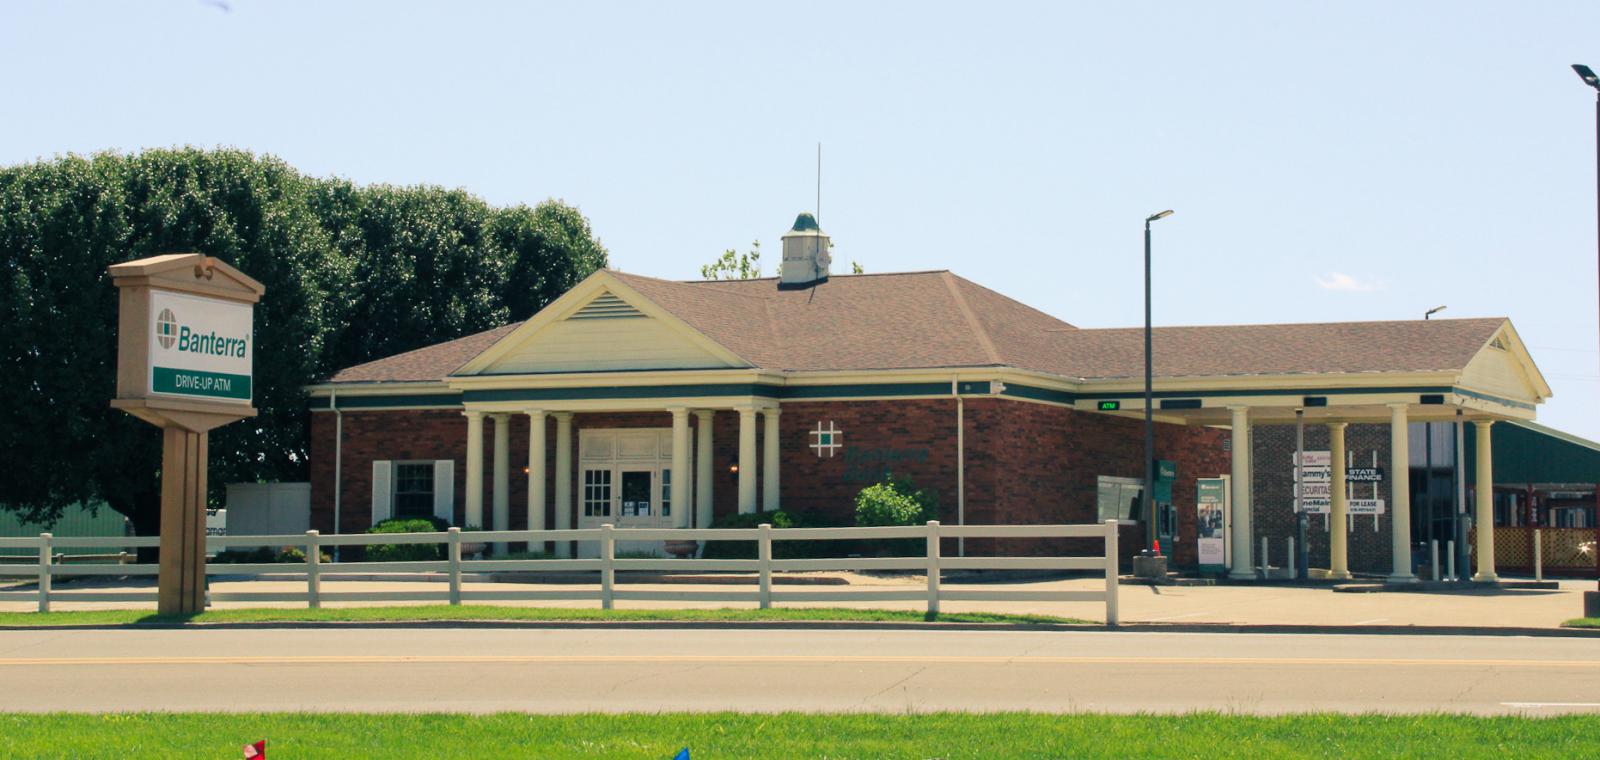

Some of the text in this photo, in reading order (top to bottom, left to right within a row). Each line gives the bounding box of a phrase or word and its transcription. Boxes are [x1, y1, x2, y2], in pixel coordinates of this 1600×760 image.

[178, 326, 246, 358] Banterra
[175, 374, 231, 391] DRIVE-UP ATM
[1101, 402, 1116, 410] ATM
[1302, 469, 1331, 479] ammy's
